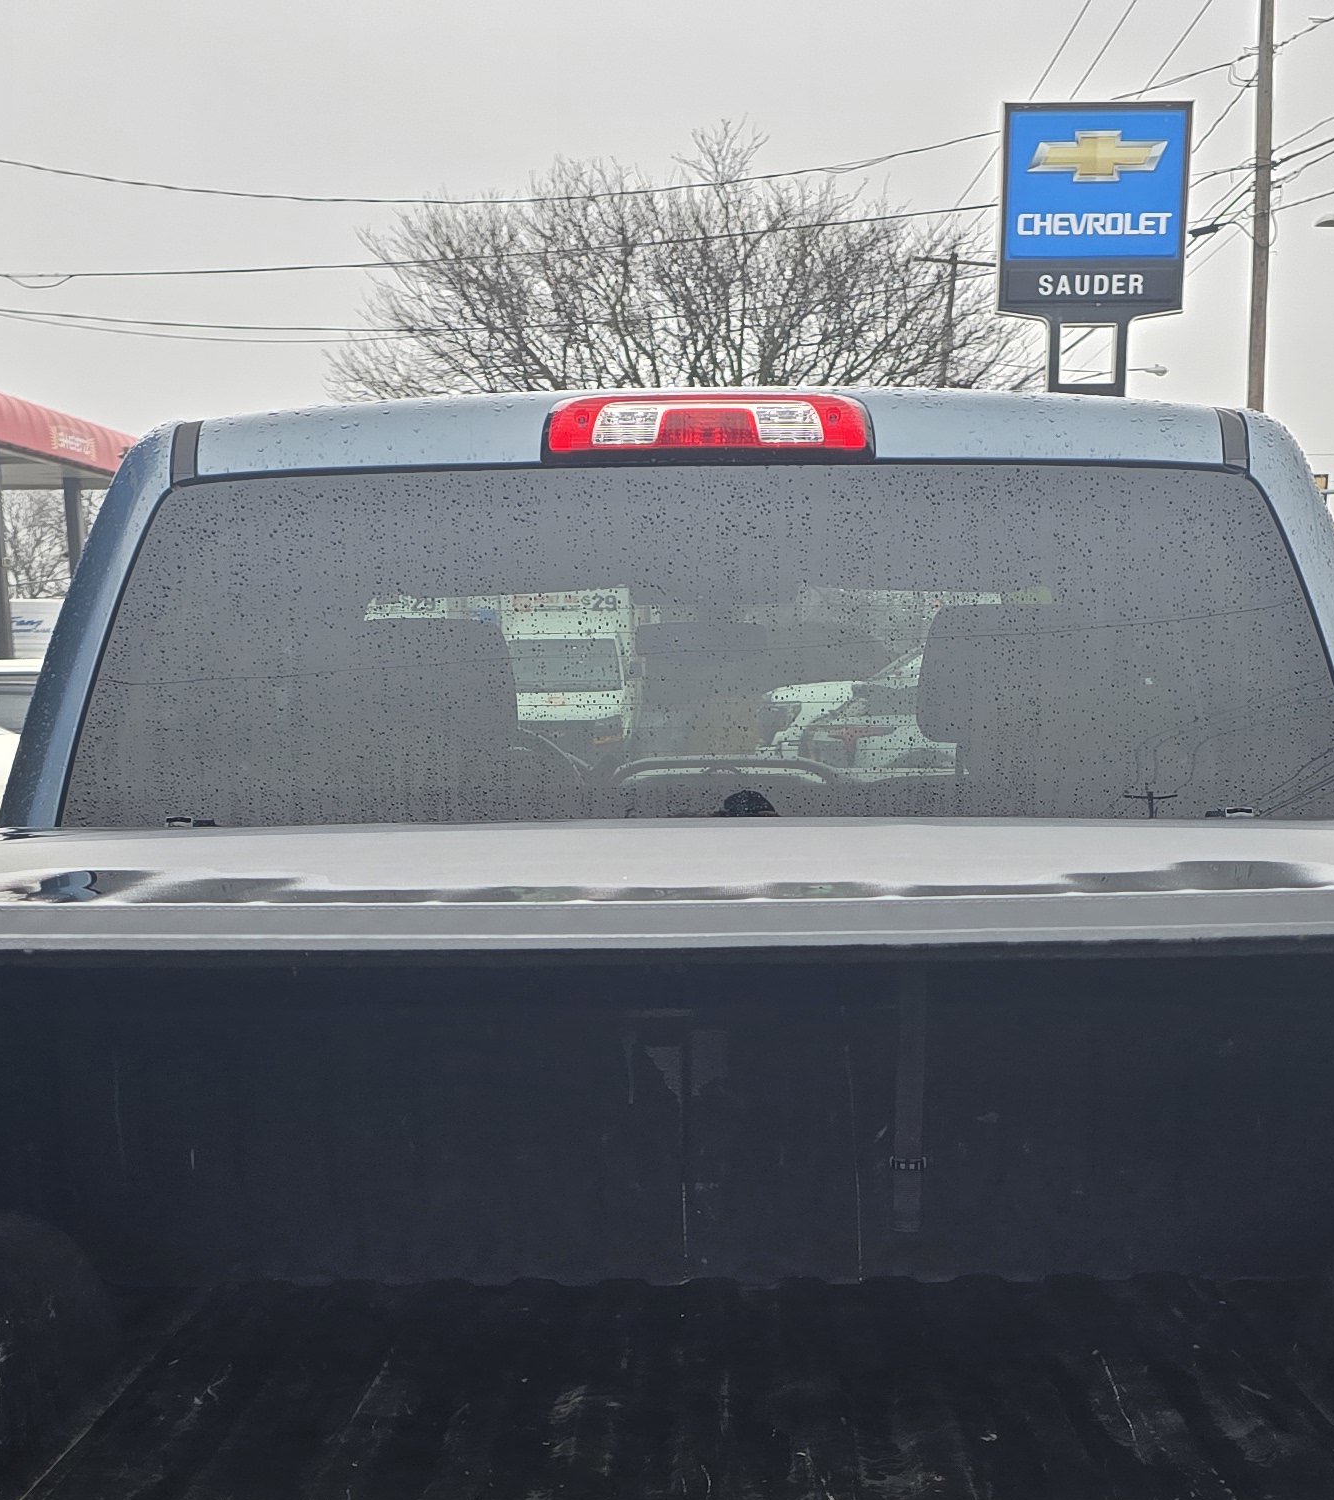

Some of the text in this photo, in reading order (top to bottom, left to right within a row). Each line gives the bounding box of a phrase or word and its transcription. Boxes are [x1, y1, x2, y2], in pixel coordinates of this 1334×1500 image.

[1017, 212, 1173, 236] CHEVROLET
[1038, 274, 1144, 295] SAUDER
[580, 594, 617, 611] $29
